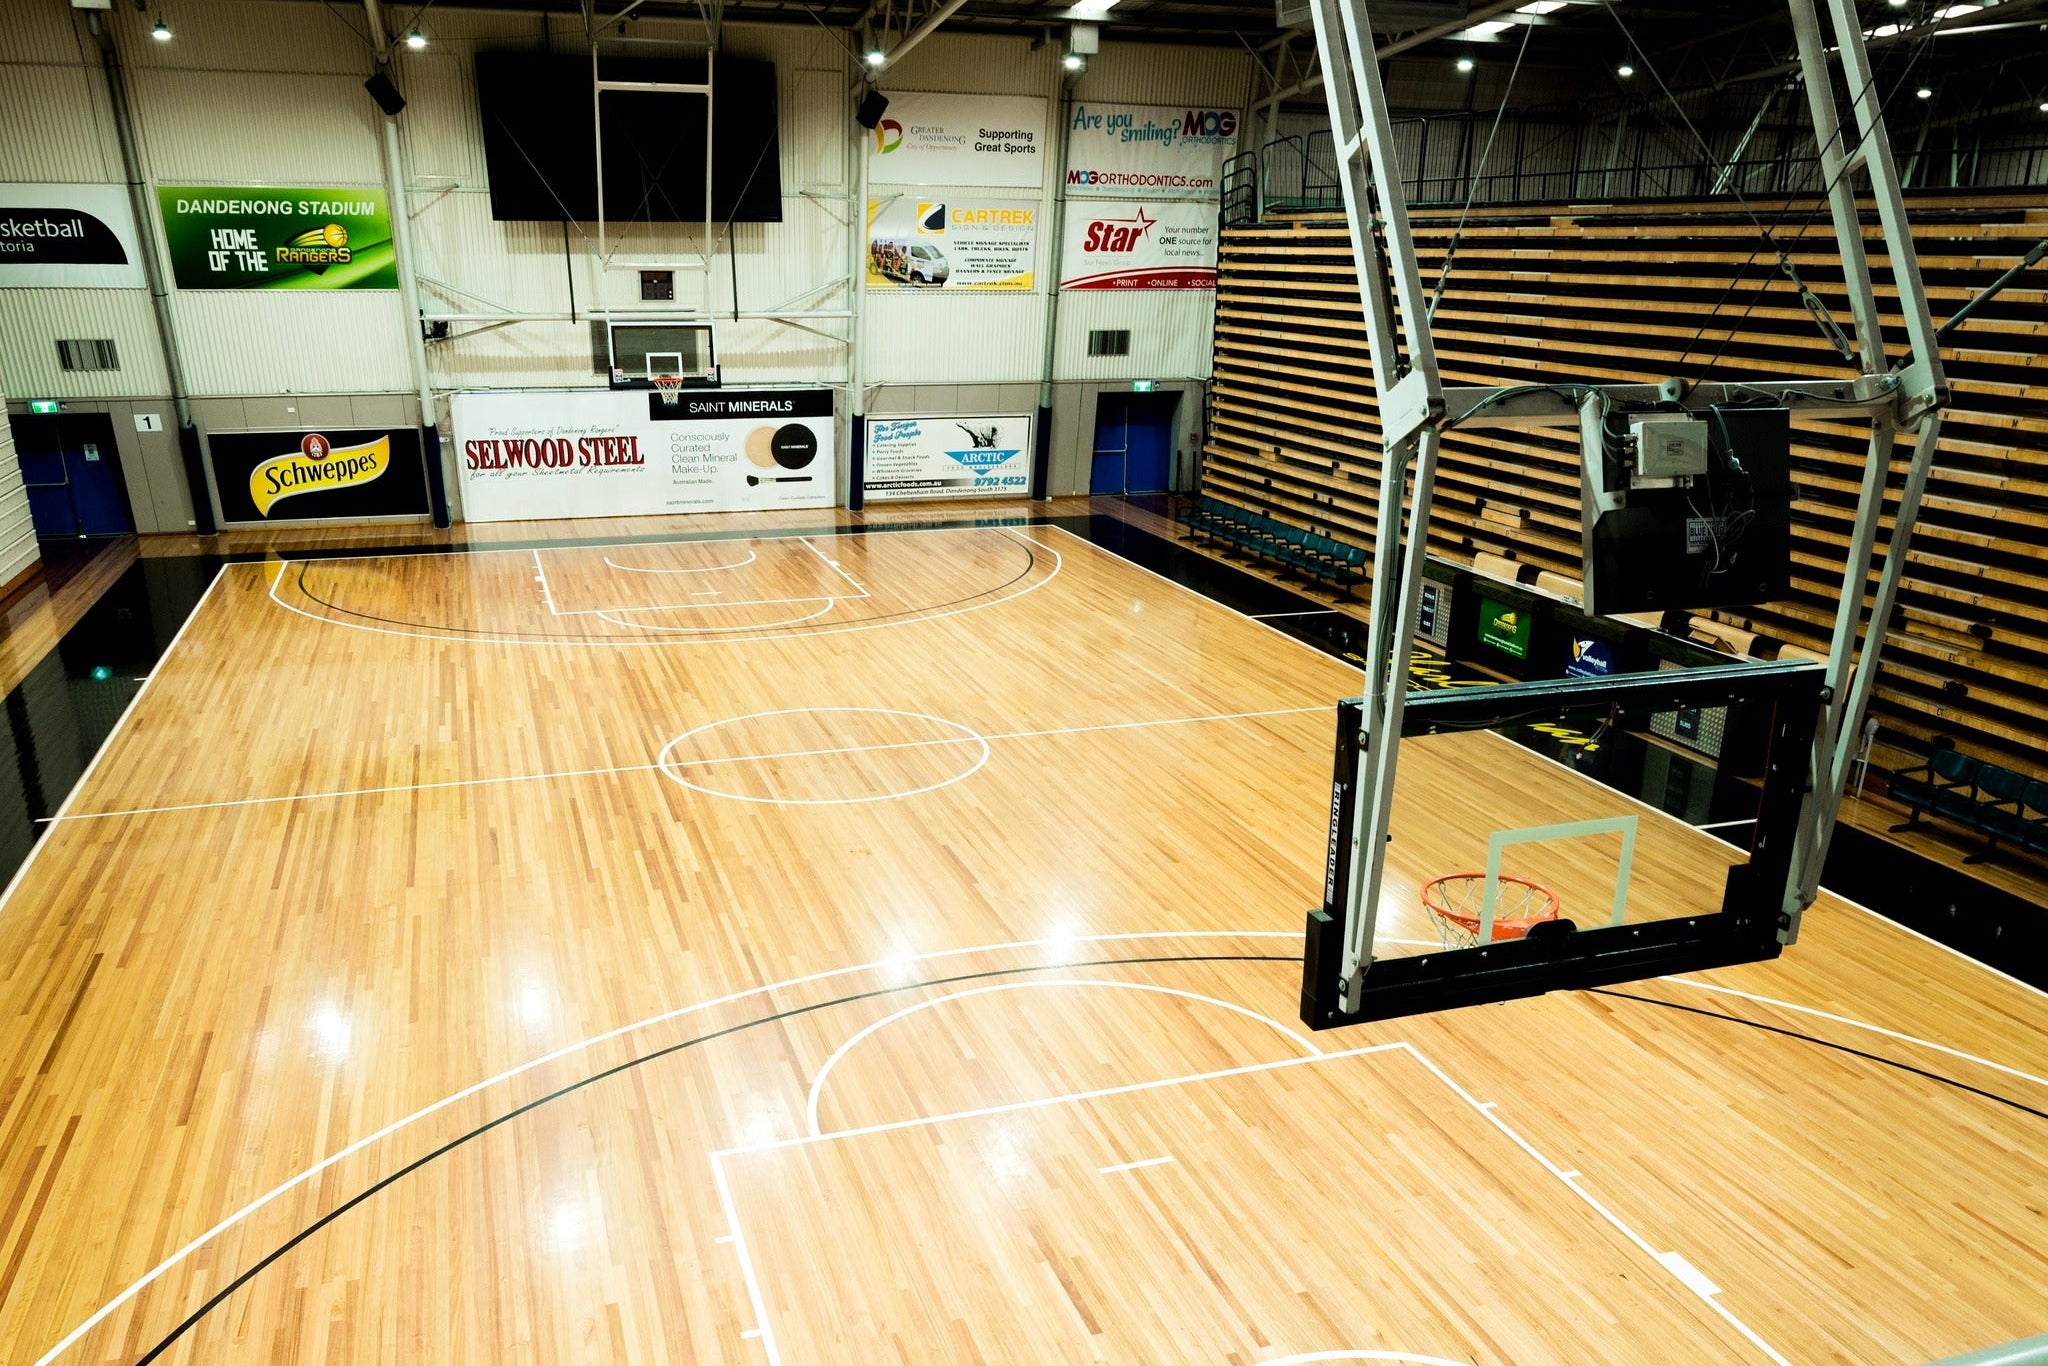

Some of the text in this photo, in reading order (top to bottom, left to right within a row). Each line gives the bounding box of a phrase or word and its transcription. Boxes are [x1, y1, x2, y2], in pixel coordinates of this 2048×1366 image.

[1073, 106, 1132, 136] Are you
[910, 126, 944, 134] GREATER
[979, 128, 1034, 142] Supporting
[1121, 119, 1182, 146] smiling?
[920, 134, 966, 144] DANDENONG
[1182, 136, 1236, 145] ORTHODONTICS
[974, 142, 1036, 154] Great Sports
[176, 200, 374, 216] DANDENONG STADIUM
[952, 208, 1034, 224] CARTREK
[1164, 226, 1209, 234] Your number
[211, 228, 258, 250] HOME
[1084, 221, 1144, 252] Star
[1159, 237, 1176, 245] ONE
[1202, 238, 1212, 246] for
[276, 247, 351, 262] RANGERS
[1164, 248, 1181, 256] local
[208, 250, 268, 272] OF THE
[689, 400, 793, 413] SAINT MINERALS
[143, 416, 152, 430] 1
[547, 426, 554, 436] of
[670, 432, 730, 442] Consciously
[465, 436, 645, 470] SELWOOD STEEL
[671, 443, 711, 452] Curated
[672, 453, 738, 463] Clean Mineral
[962, 452, 1004, 462] ARCTIC
[264, 452, 377, 494] Schweppes
[532, 468, 582, 476] Sheetmetal
[587, 466, 645, 477] Requirements
[866, 481, 942, 489] www.arcticfoods.com.au
[974, 476, 1026, 486] 9792 4522
[1328, 790, 1340, 886] RINGLEADER
